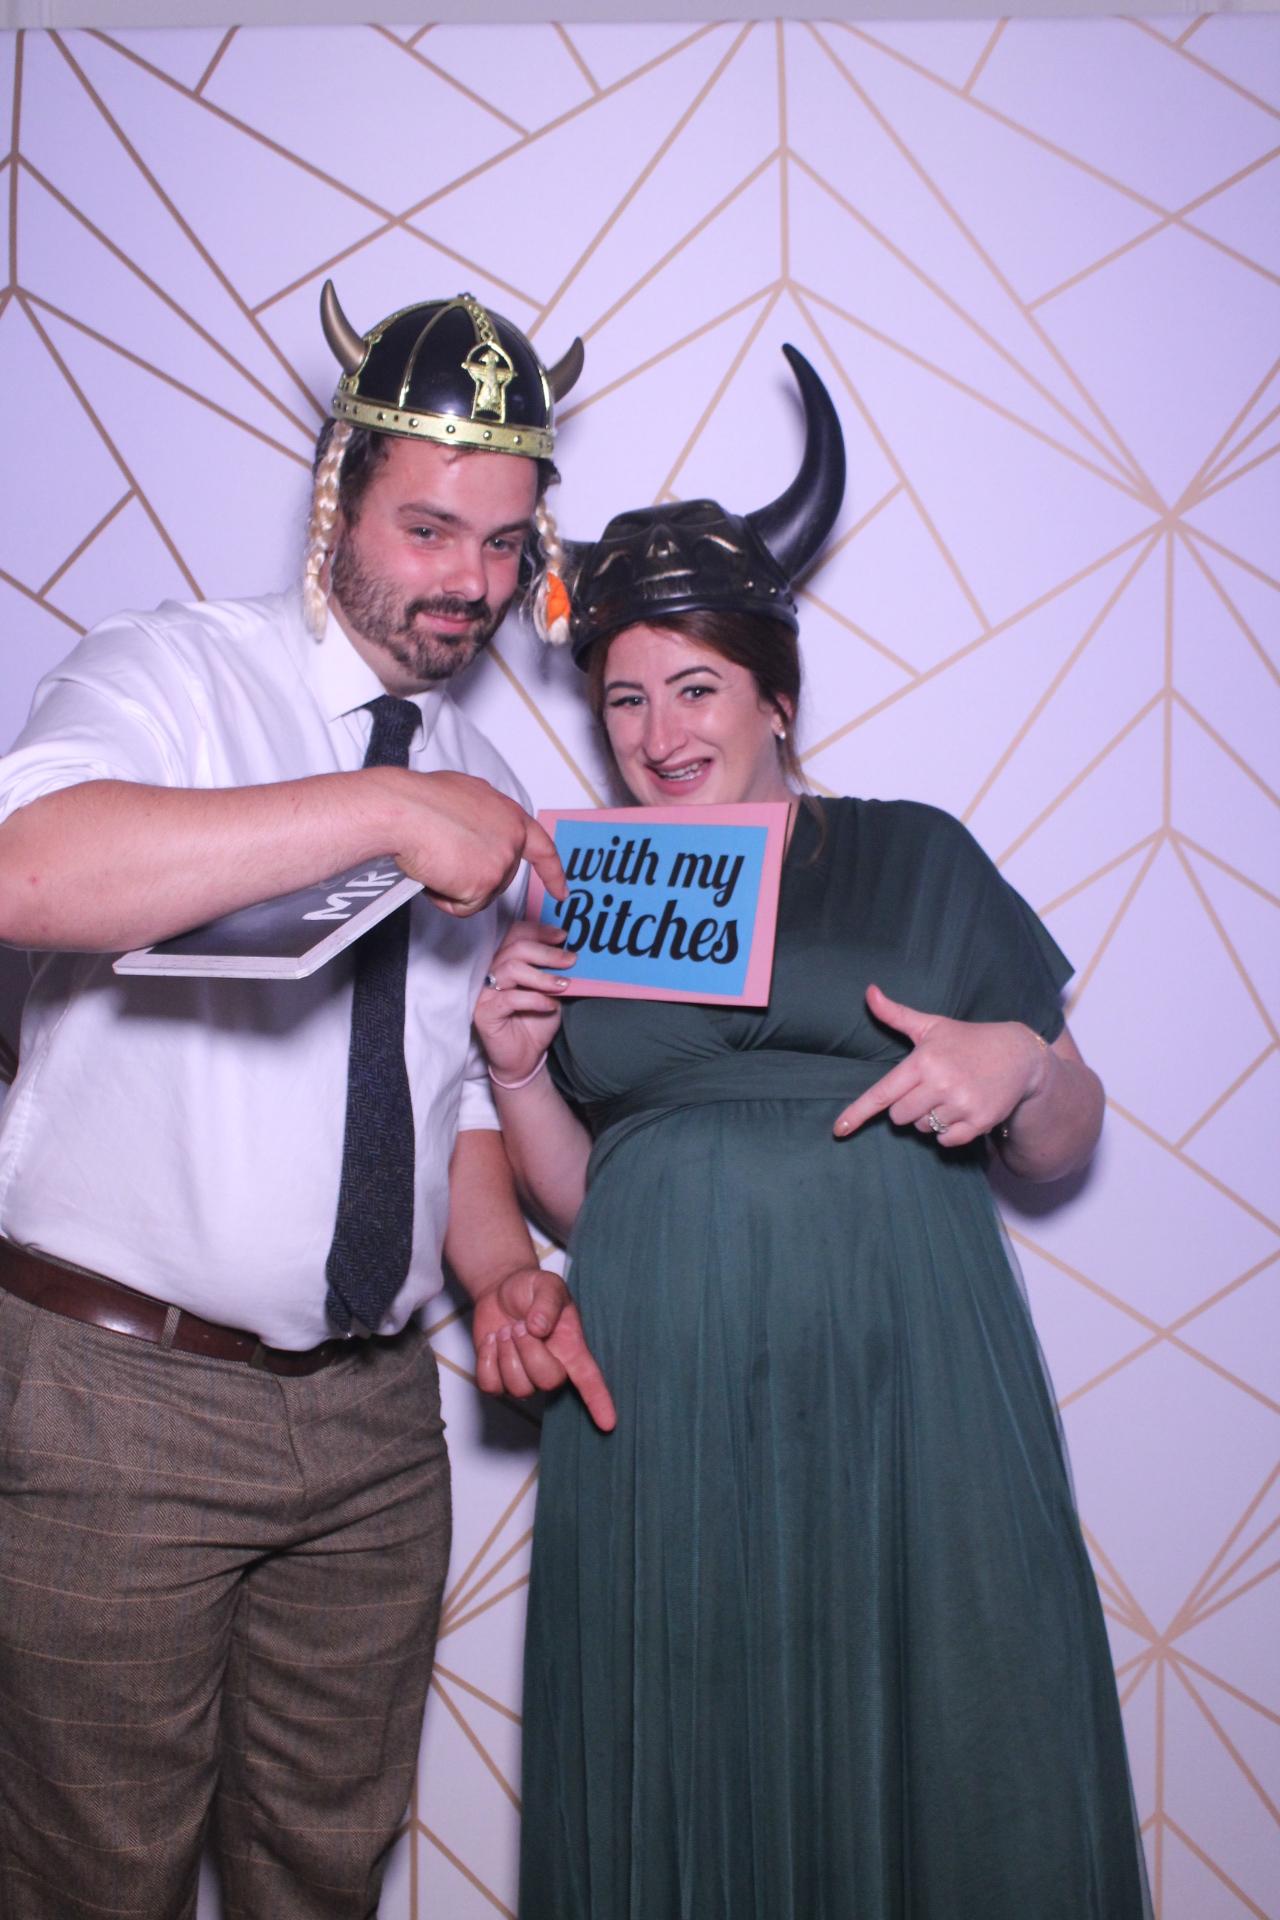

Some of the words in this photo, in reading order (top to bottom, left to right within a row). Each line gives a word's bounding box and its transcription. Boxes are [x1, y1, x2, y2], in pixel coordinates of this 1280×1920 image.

[565, 835, 660, 886] with
[667, 852, 746, 908] my
[554, 888, 740, 965] Bitches
